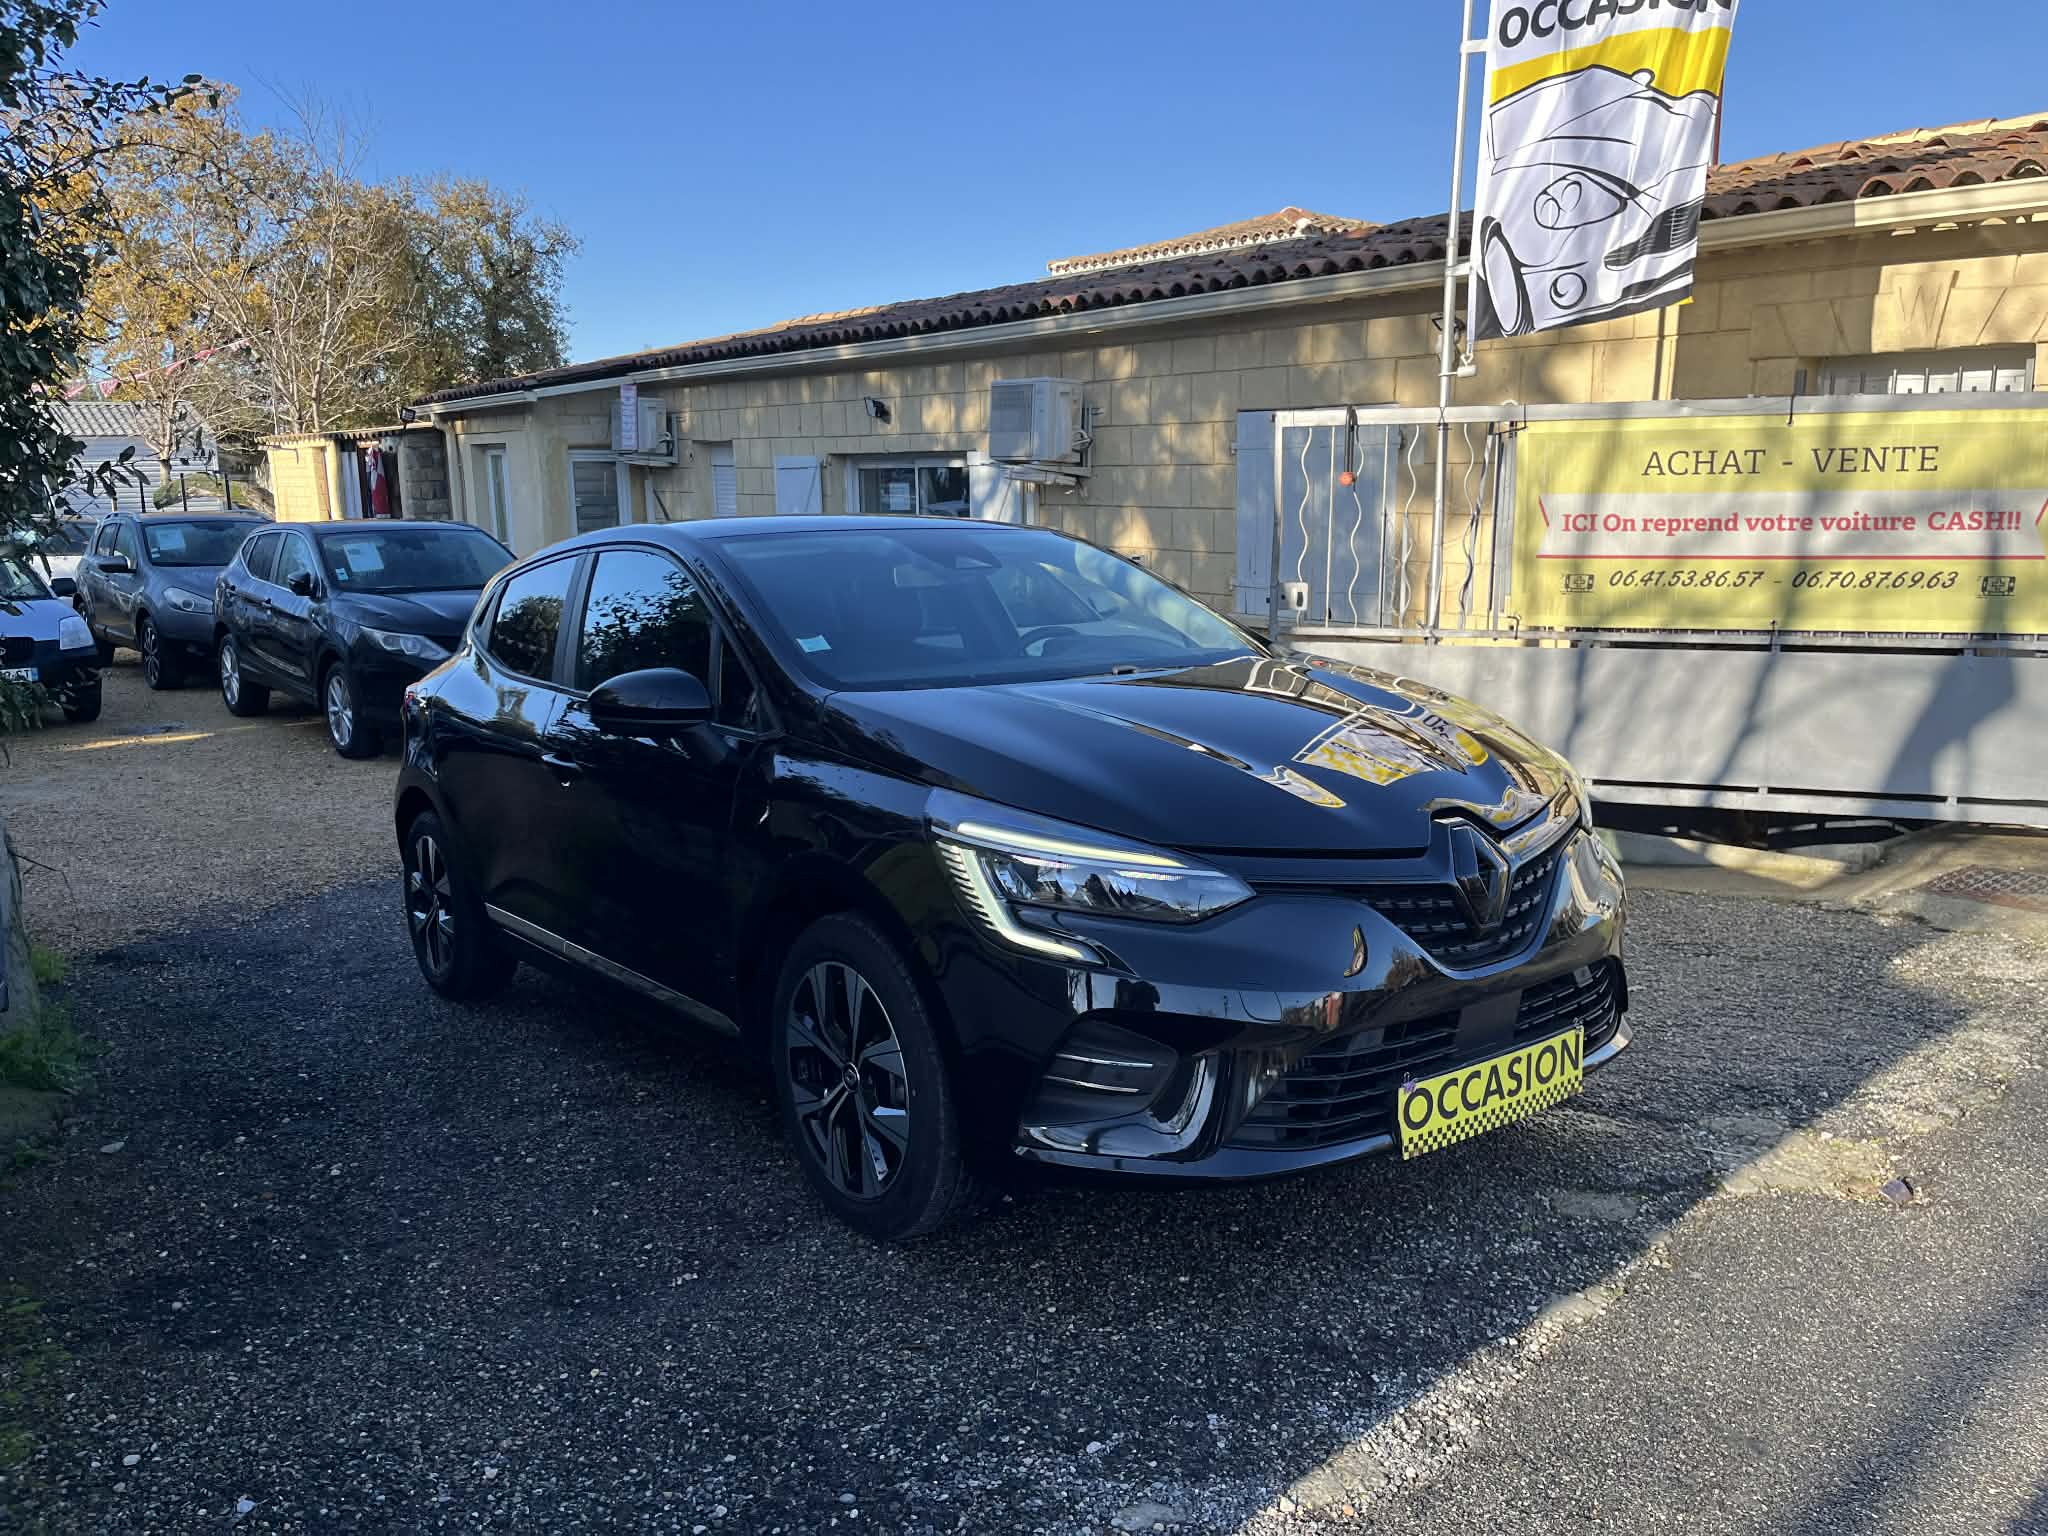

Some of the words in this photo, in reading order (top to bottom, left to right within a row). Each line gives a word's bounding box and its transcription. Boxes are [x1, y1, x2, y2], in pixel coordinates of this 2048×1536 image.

[1641, 449, 1766, 476] ACHAT
[1811, 446, 1939, 473] VENTE
[1562, 513, 1598, 532] ICI
[1602, 513, 1637, 532] On
[1641, 511, 1739, 537] reprend
[1744, 513, 1814, 532] votre
[1819, 511, 1916, 532] voiture
[1927, 511, 2021, 531] CASH!!
[1608, 570, 1765, 588] 06.41.53.86.57
[1791, 571, 1959, 590] 06.70.87.69.63
[1403, 1033, 1580, 1131] OCCASION
